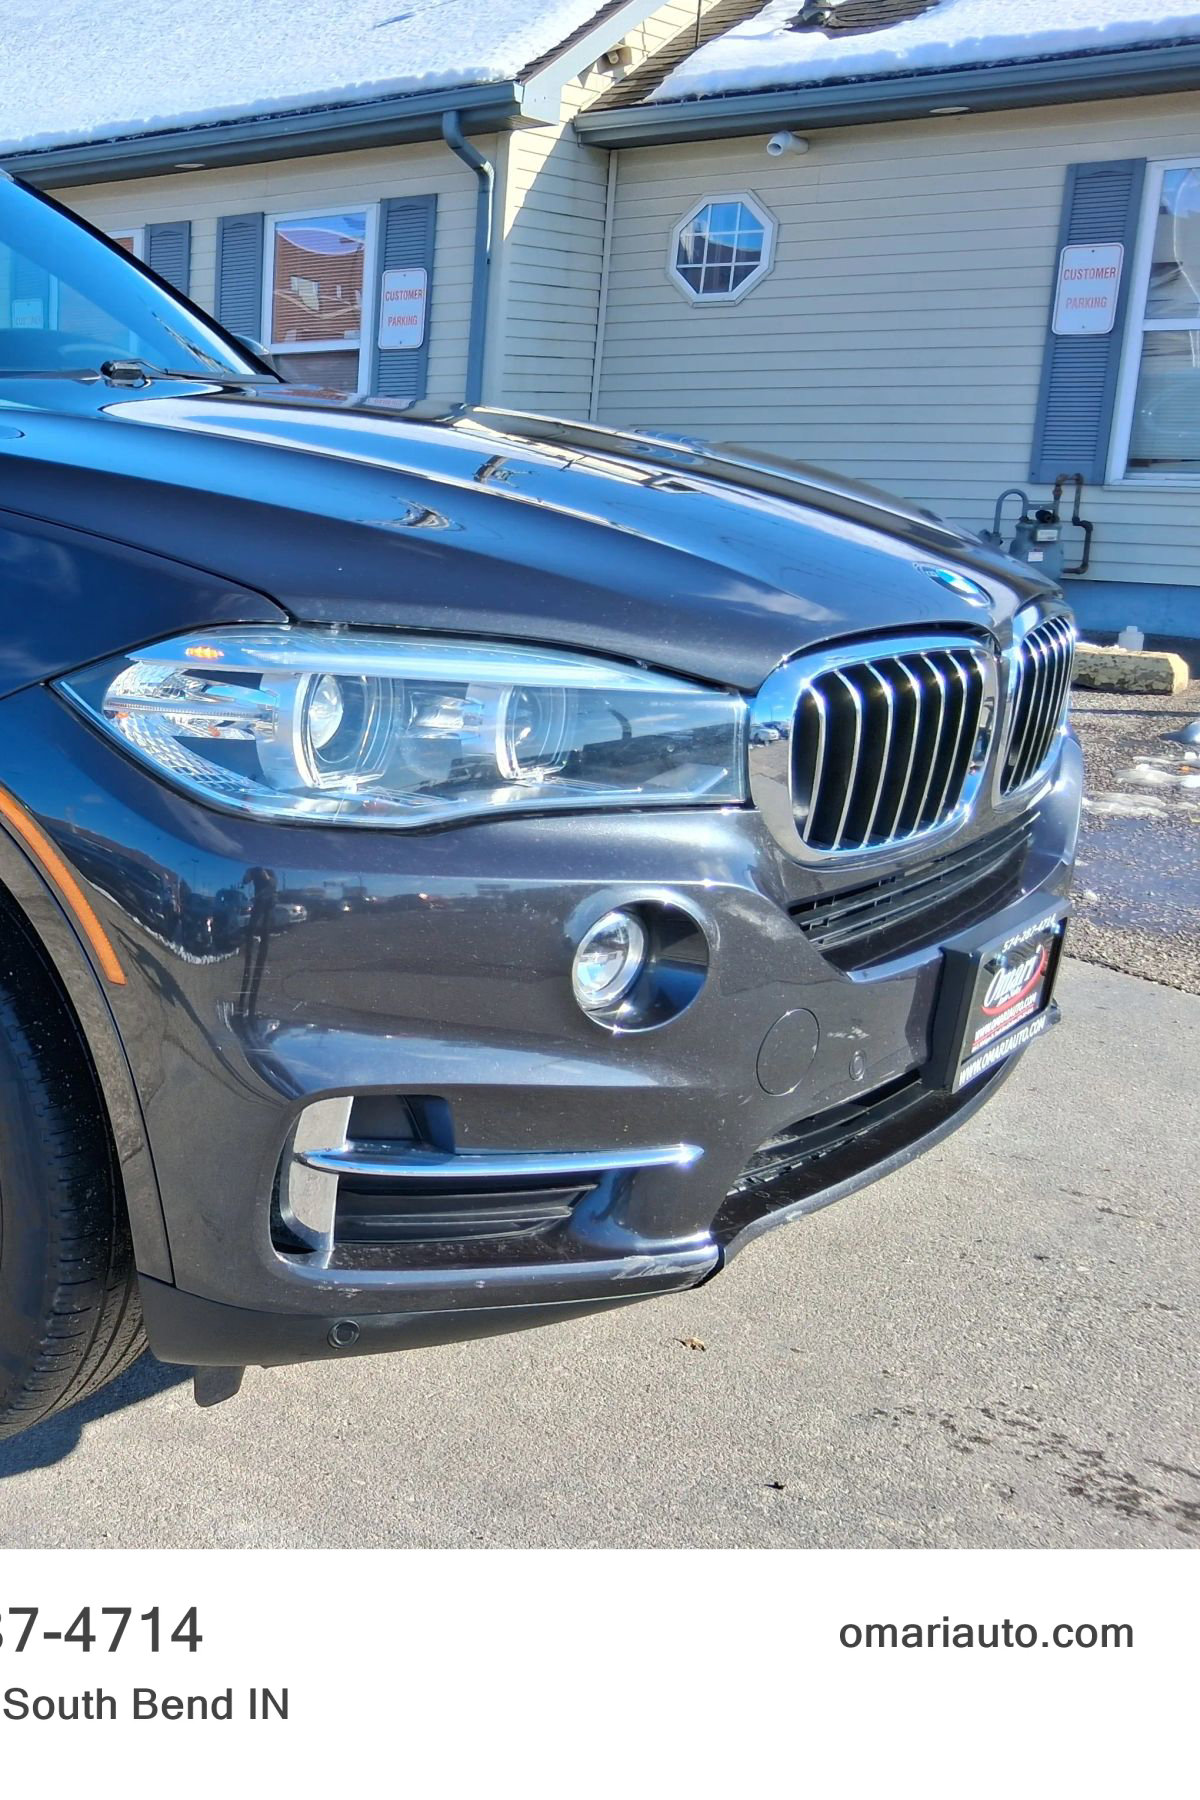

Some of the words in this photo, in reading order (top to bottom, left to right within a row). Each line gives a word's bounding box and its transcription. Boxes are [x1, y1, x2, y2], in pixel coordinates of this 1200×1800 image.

[1064, 266, 1117, 280] CUSTOMER
[385, 289, 423, 301] CUSTOMER
[1066, 296, 1107, 309] PARKING
[388, 315, 418, 326] PARKING
